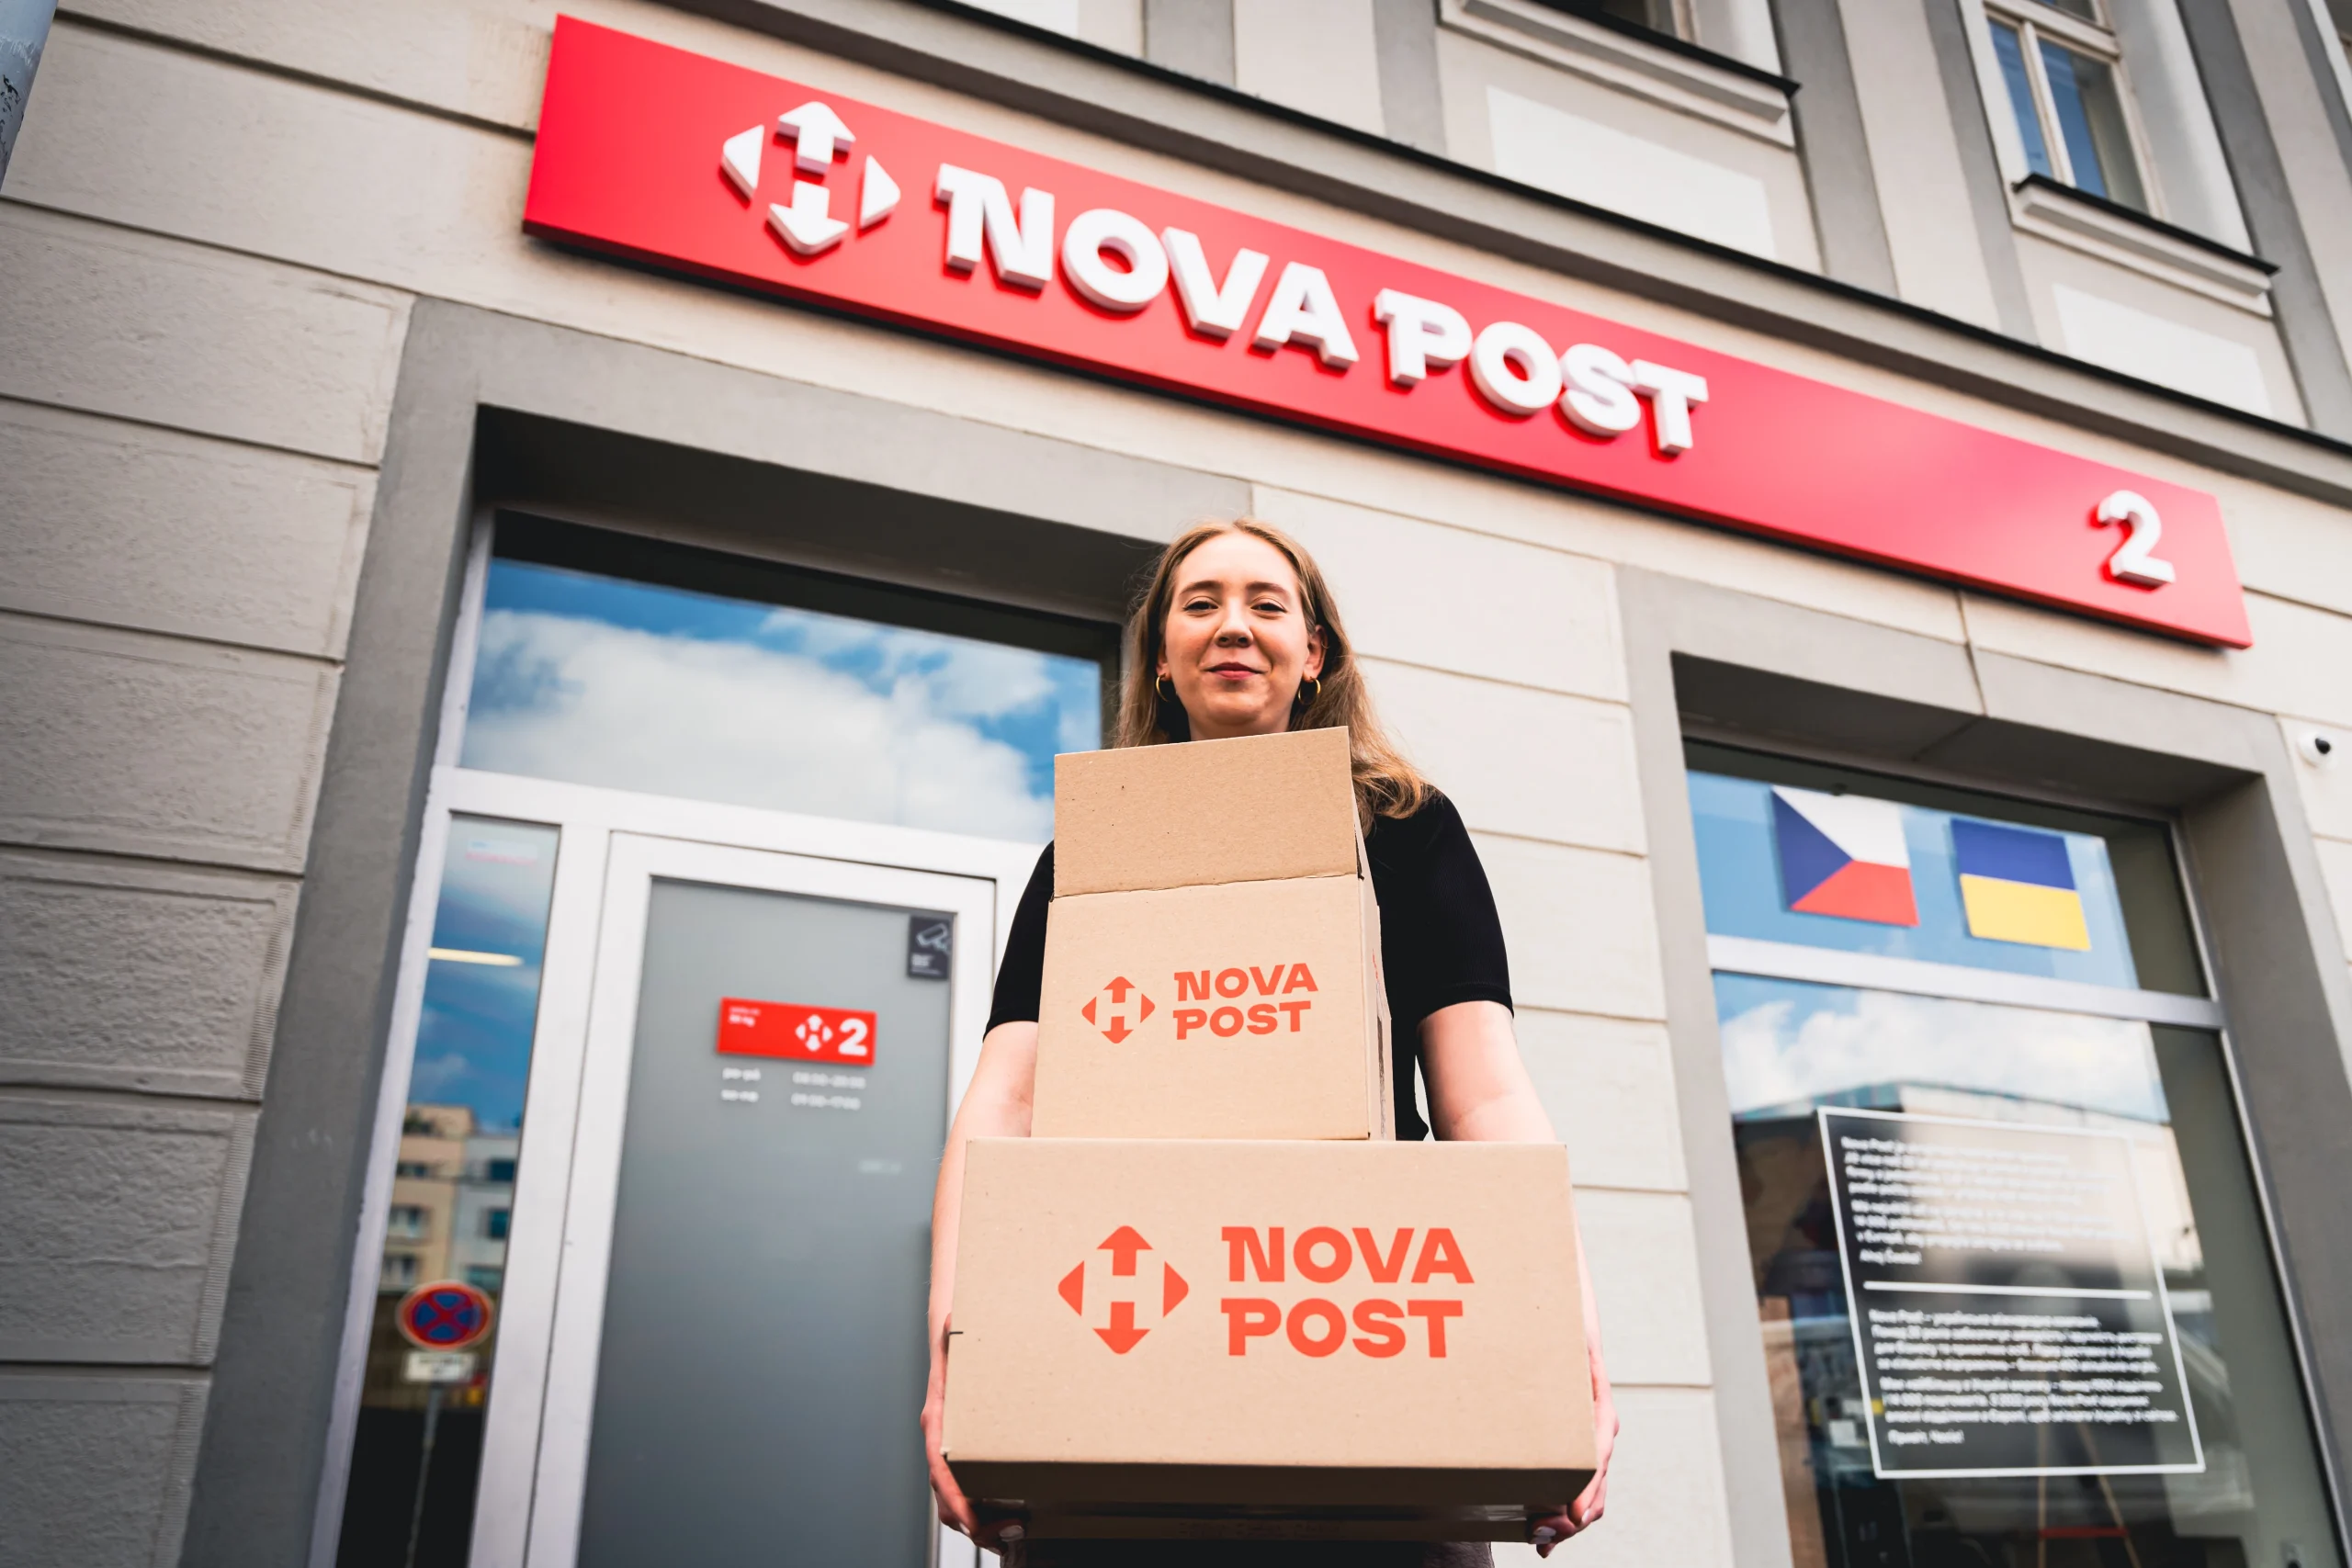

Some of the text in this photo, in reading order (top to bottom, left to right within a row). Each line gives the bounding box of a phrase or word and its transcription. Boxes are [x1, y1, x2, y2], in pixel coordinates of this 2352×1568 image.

[936, 163, 1709, 455] NOVA POST
[2098, 490, 2176, 587] 2
[1173, 963, 1319, 1002] NOVA
[838, 1018, 868, 1056] 2
[1172, 1000, 1312, 1040] POST
[1221, 1226, 1476, 1284] NOVA
[1220, 1298, 1464, 1358] POST
